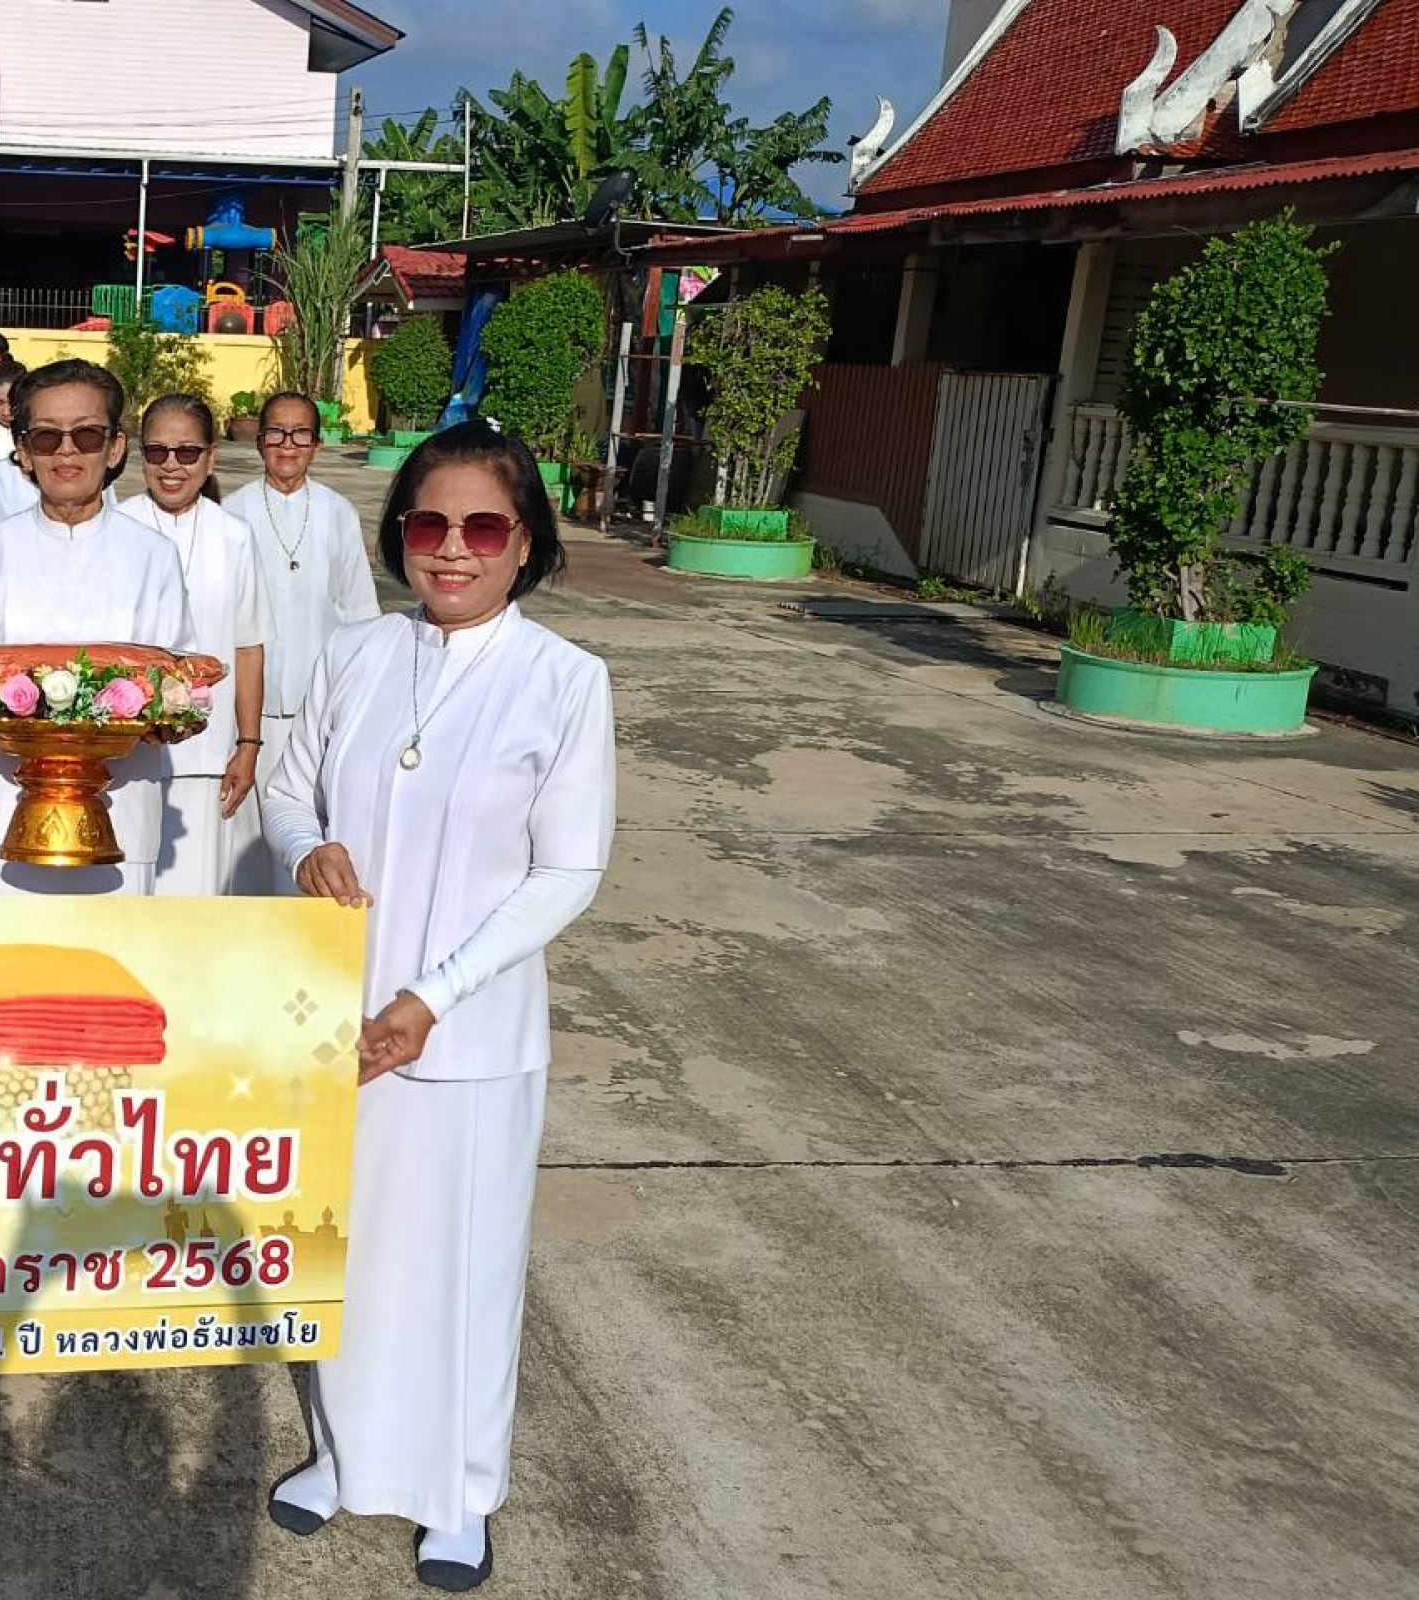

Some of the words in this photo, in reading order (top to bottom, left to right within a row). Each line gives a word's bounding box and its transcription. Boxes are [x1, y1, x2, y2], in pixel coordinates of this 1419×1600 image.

[147, 1240, 291, 1289] 2568
[19, 1321, 42, 1356] ปี
[56, 1312, 318, 1354] หลวงพ่อธัมมชโย
